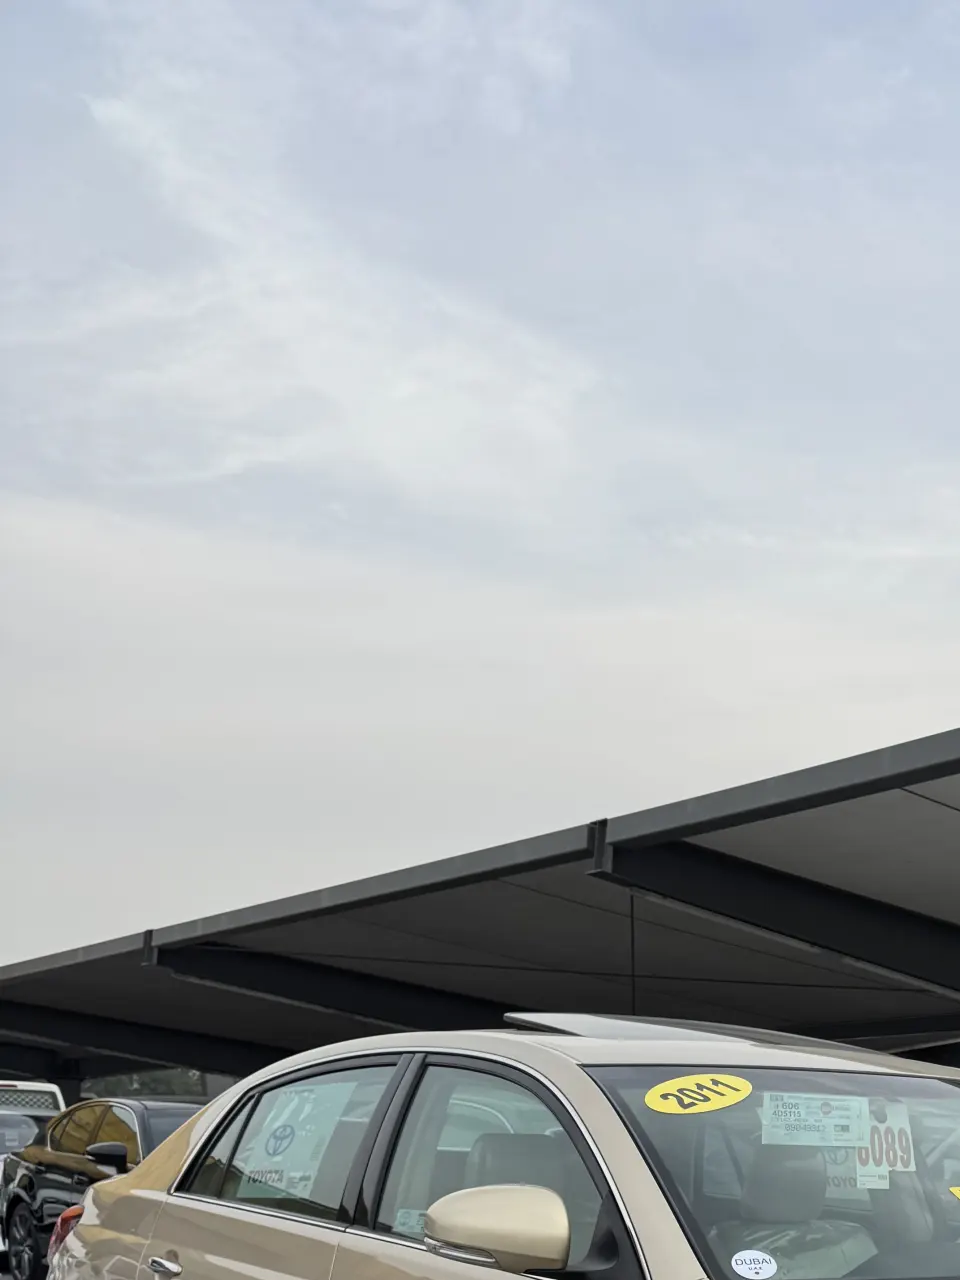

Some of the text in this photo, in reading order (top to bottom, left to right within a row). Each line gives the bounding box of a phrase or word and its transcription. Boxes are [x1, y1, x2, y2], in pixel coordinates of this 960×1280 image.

[659, 1078, 742, 1110] 2011
[247, 1169, 285, 1184] TOYOTA
[734, 1257, 773, 1266] DUBAI
